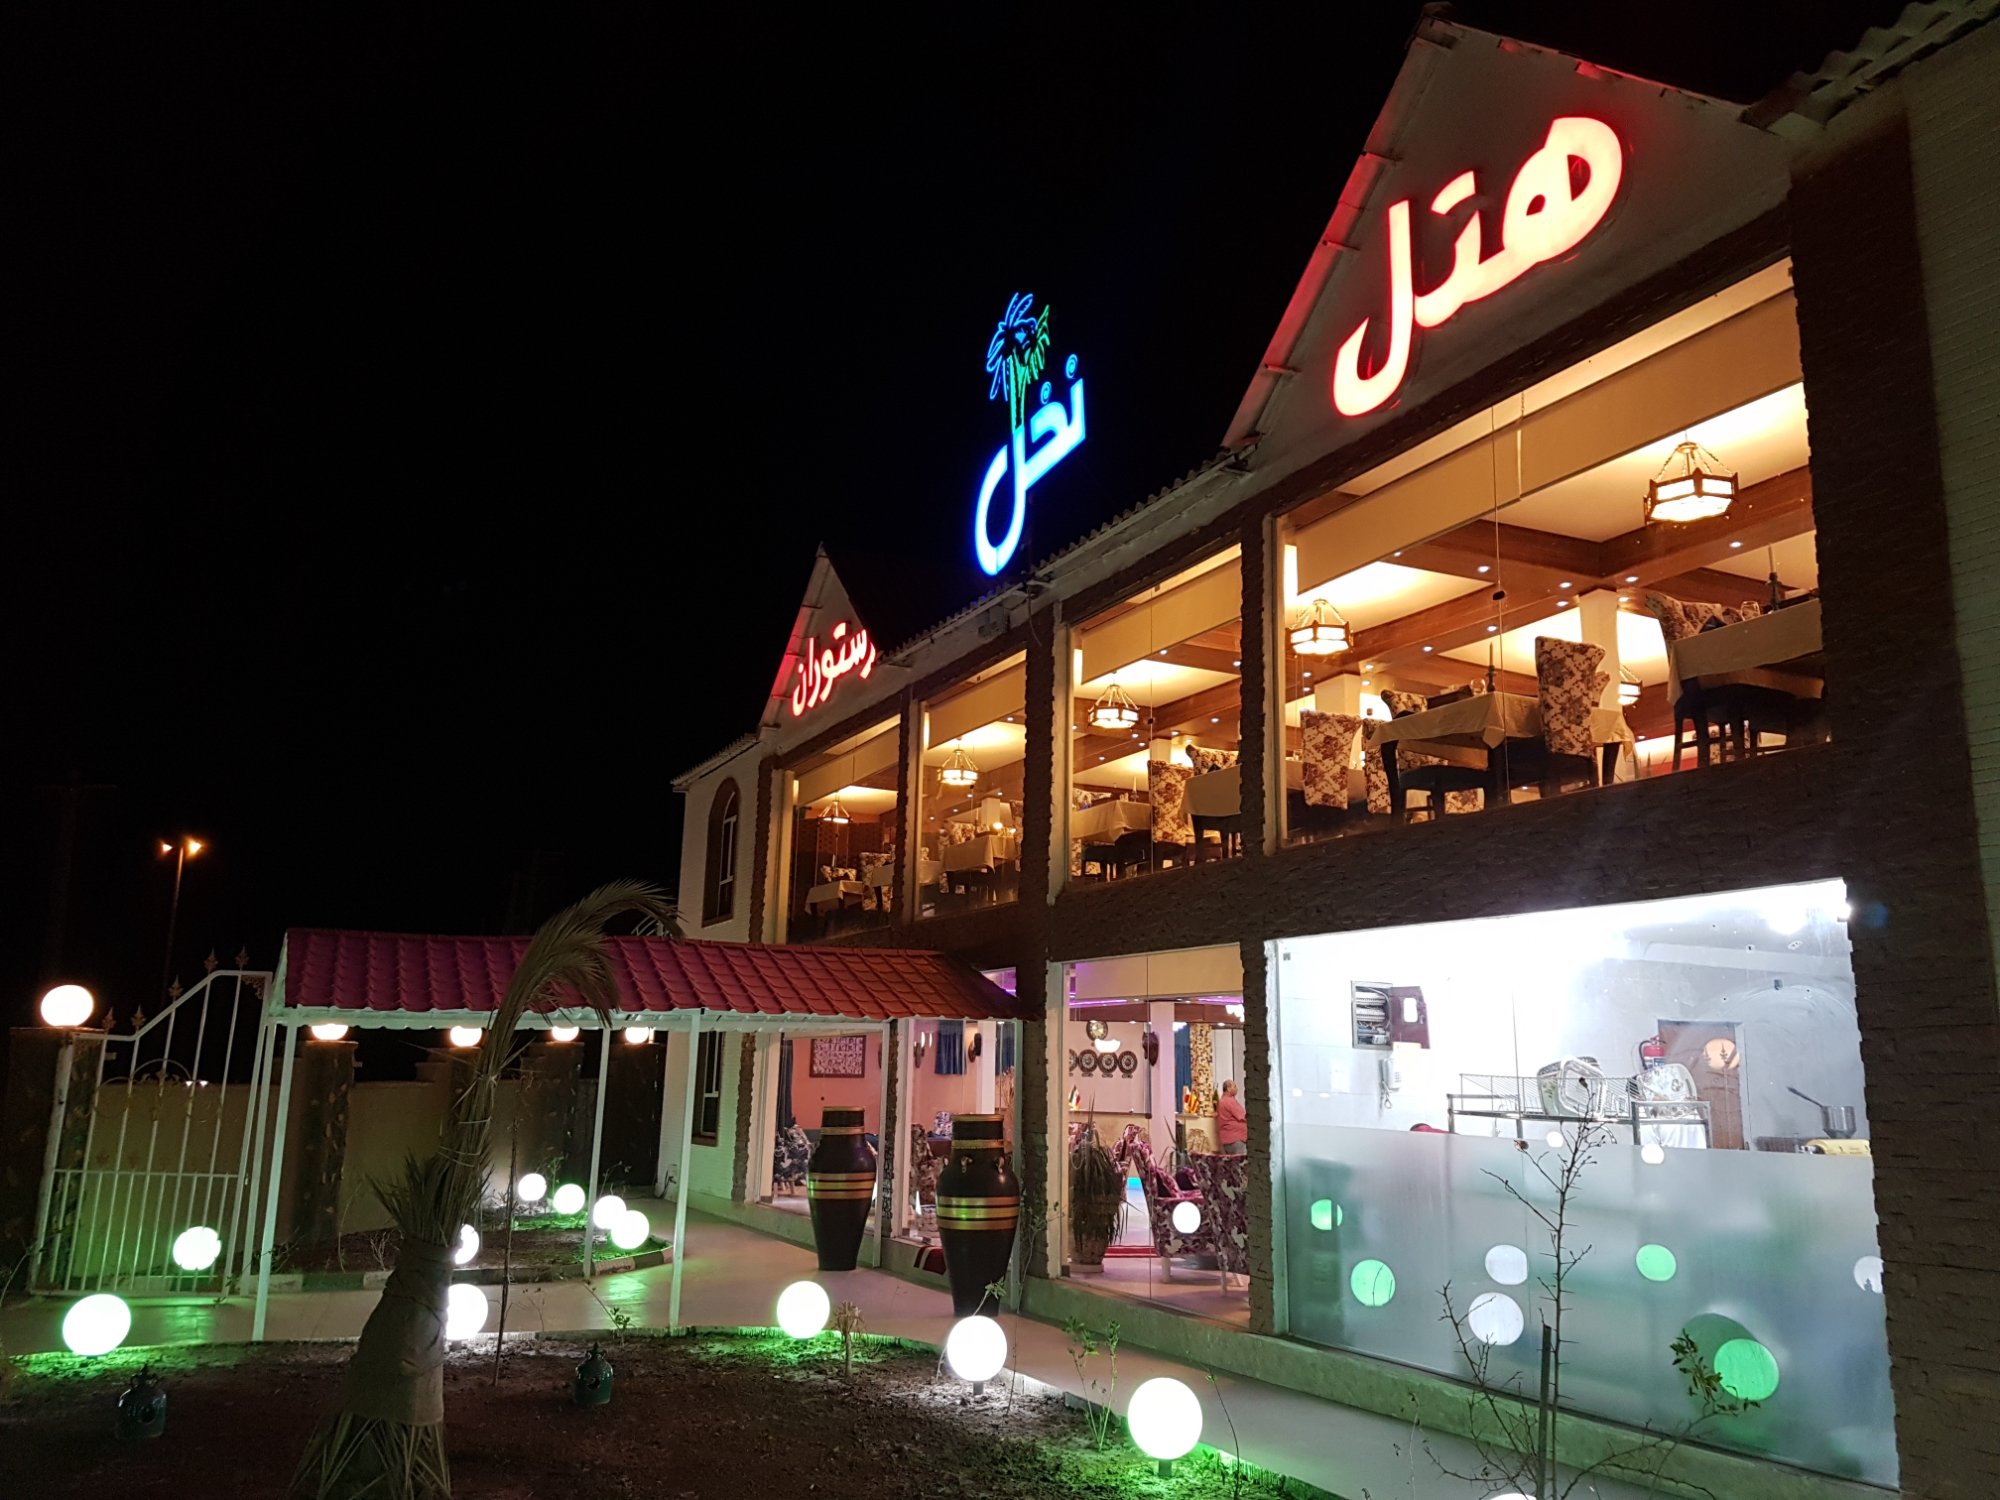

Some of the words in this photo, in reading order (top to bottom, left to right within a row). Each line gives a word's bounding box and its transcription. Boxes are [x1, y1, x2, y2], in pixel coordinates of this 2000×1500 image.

[1333, 116, 1623, 417] هتل
[975, 354, 1086, 576] نخل
[792, 621, 877, 717] رستوران
